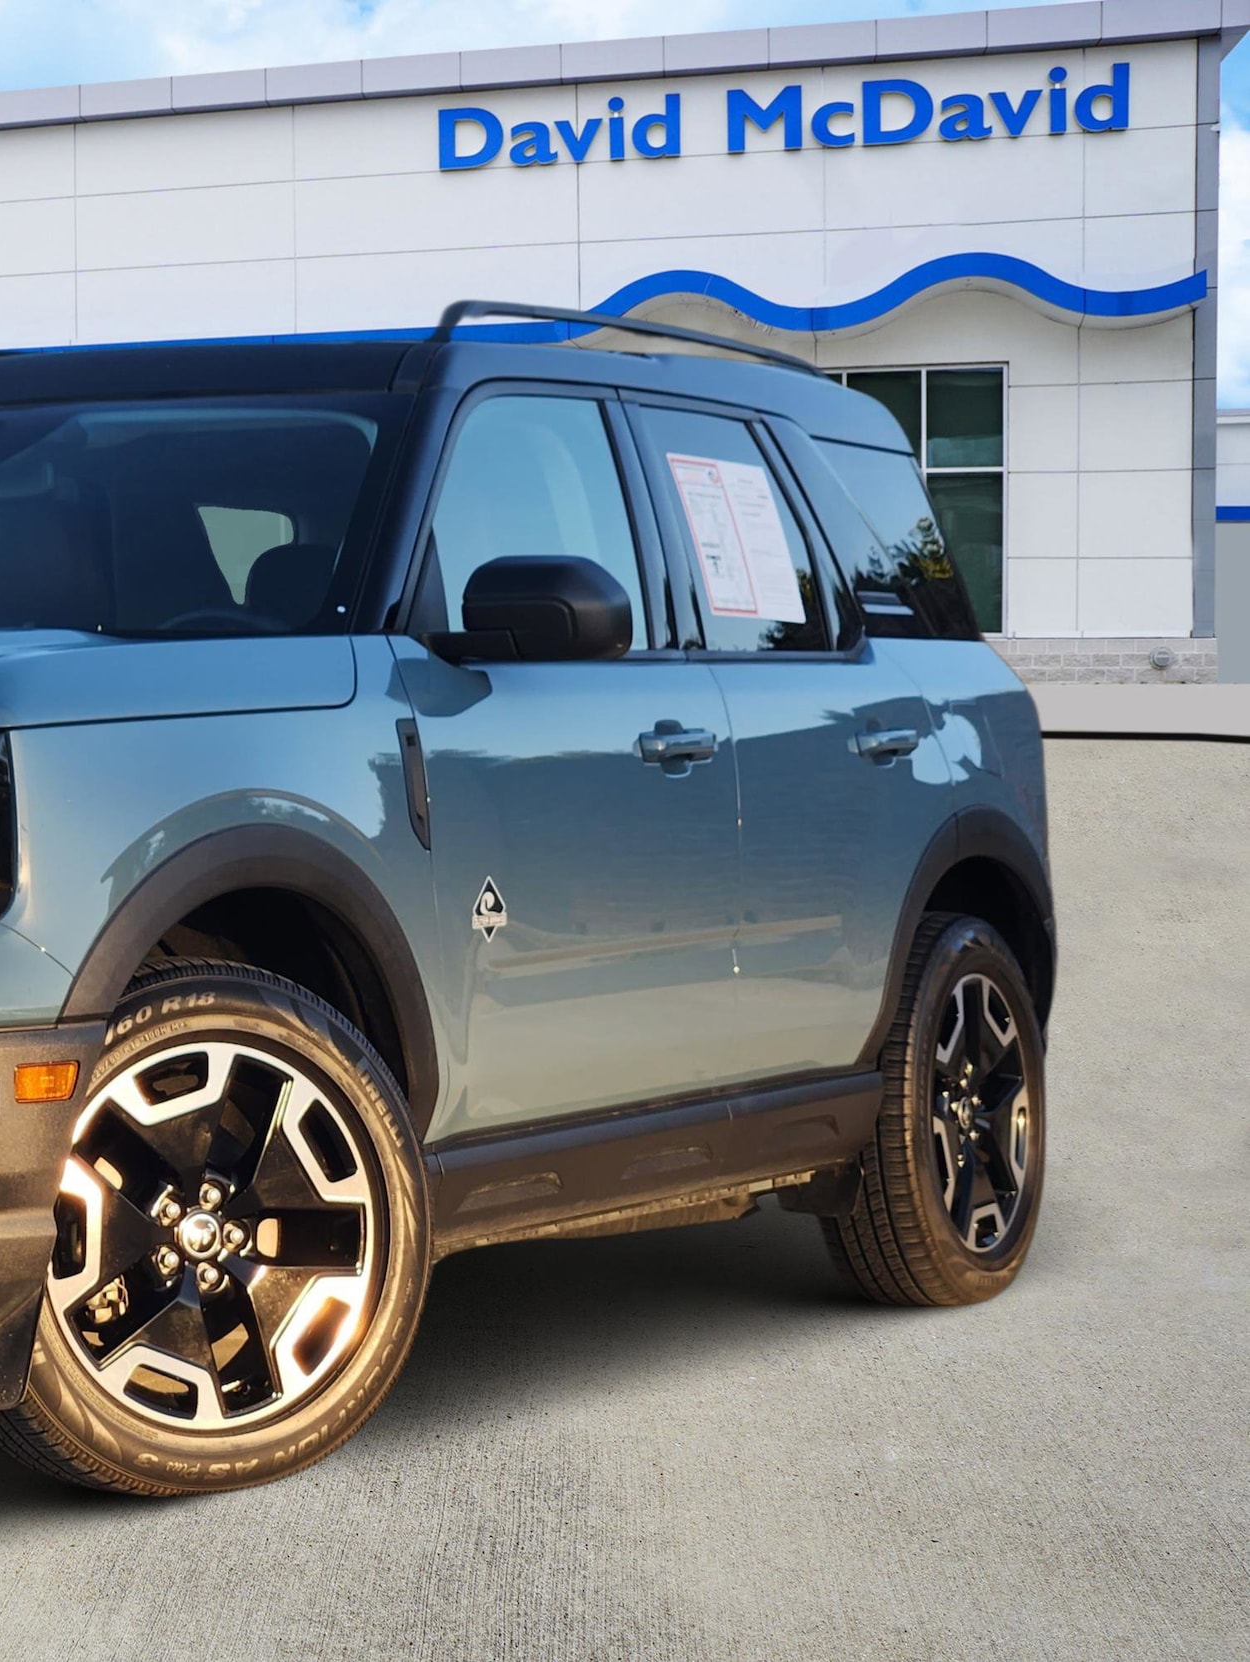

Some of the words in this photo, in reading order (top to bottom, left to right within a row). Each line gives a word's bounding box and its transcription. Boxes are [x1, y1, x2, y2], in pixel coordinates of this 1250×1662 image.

[437, 92, 681, 172] David
[726, 62, 1131, 155] McDavid
[160, 991, 216, 1014] R18
[204, 1458, 259, 1481] AS
